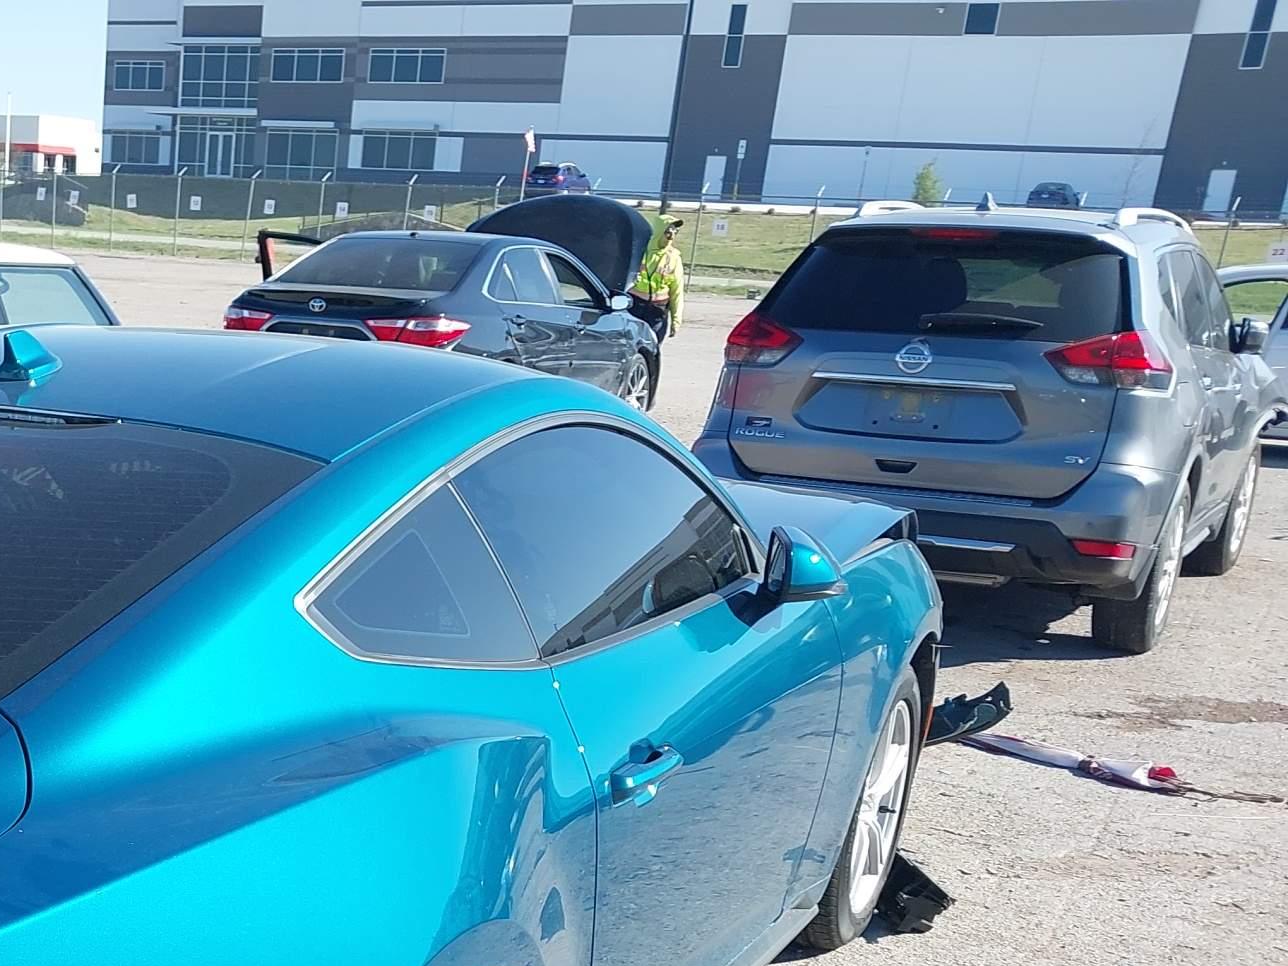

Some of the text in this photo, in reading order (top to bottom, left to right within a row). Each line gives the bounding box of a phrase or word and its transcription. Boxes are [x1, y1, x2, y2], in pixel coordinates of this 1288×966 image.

[1272, 248, 1286, 256] 22
[735, 427, 785, 439] ROGUE
[1064, 455, 1091, 465] SV
